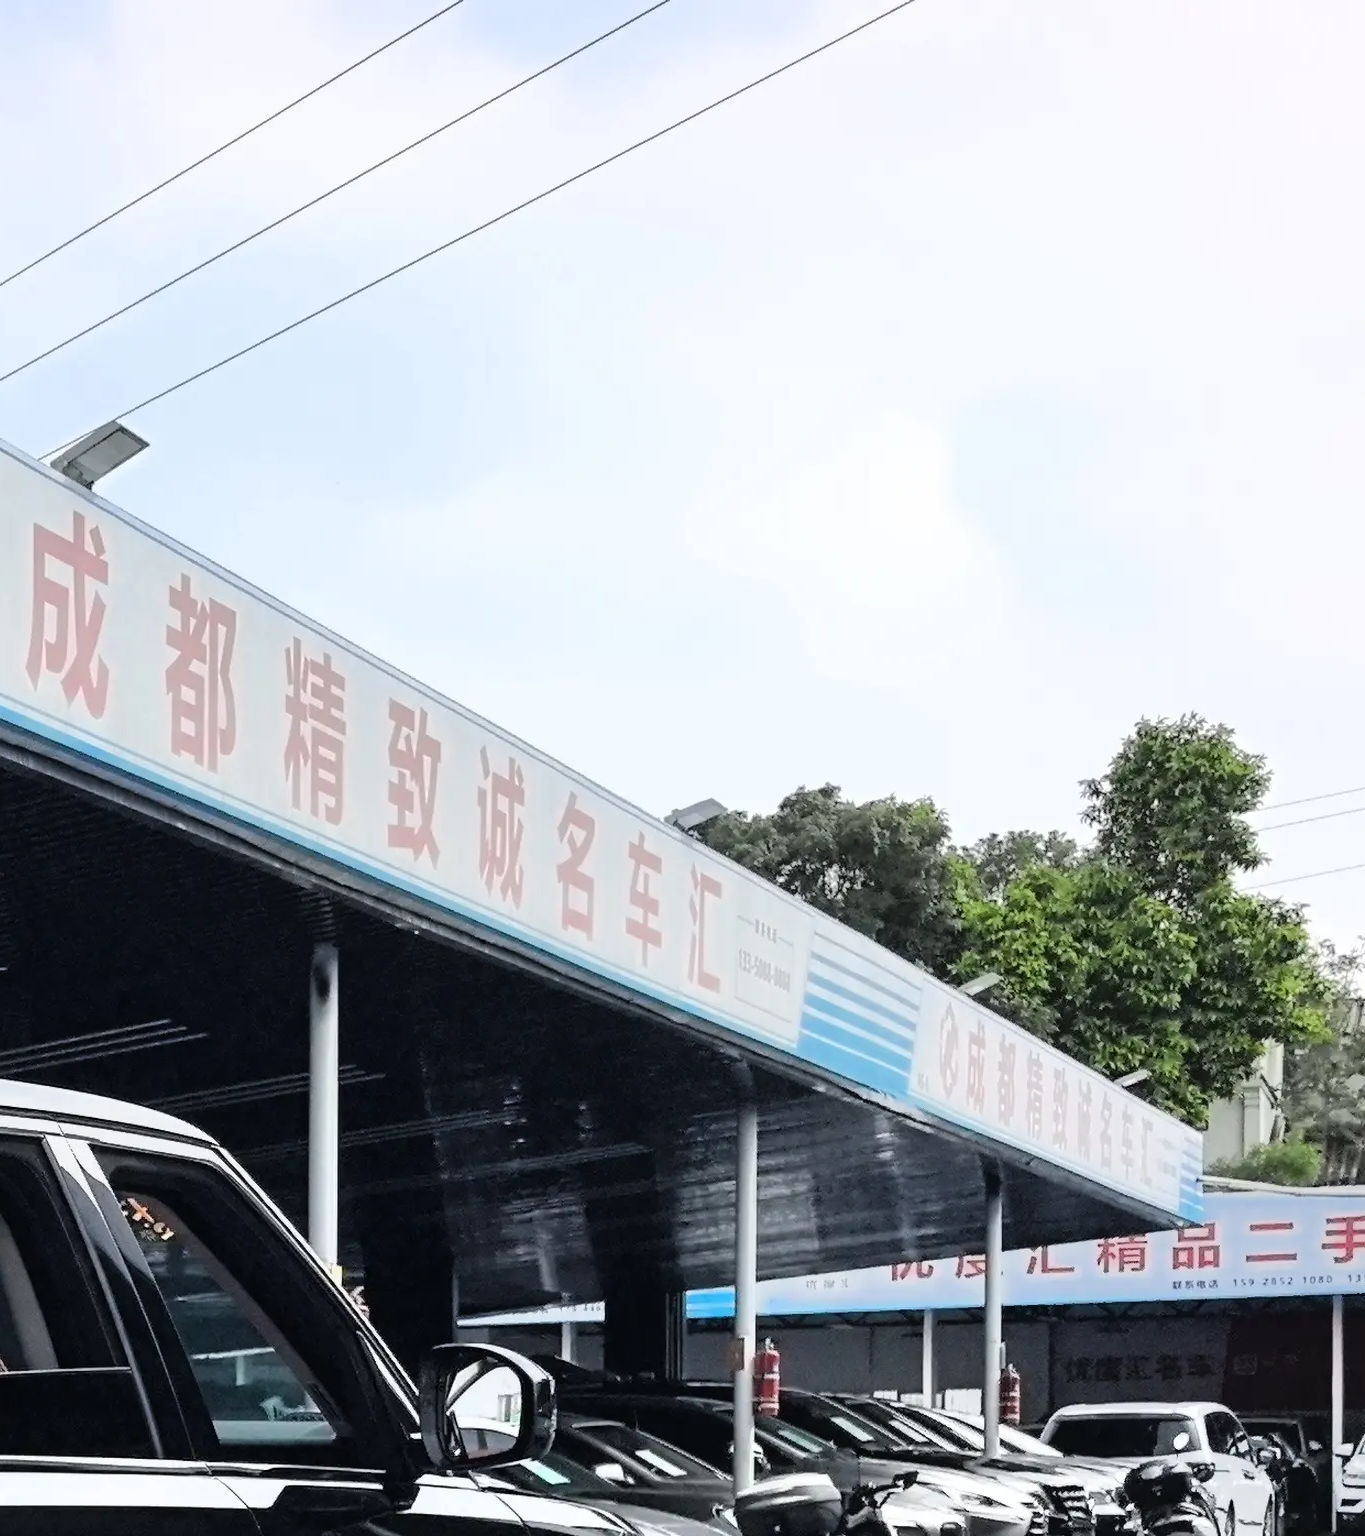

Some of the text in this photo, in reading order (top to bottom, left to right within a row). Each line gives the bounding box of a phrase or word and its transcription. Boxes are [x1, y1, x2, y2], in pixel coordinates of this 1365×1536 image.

[25, 509, 724, 994] 成都精致诚名车汇
